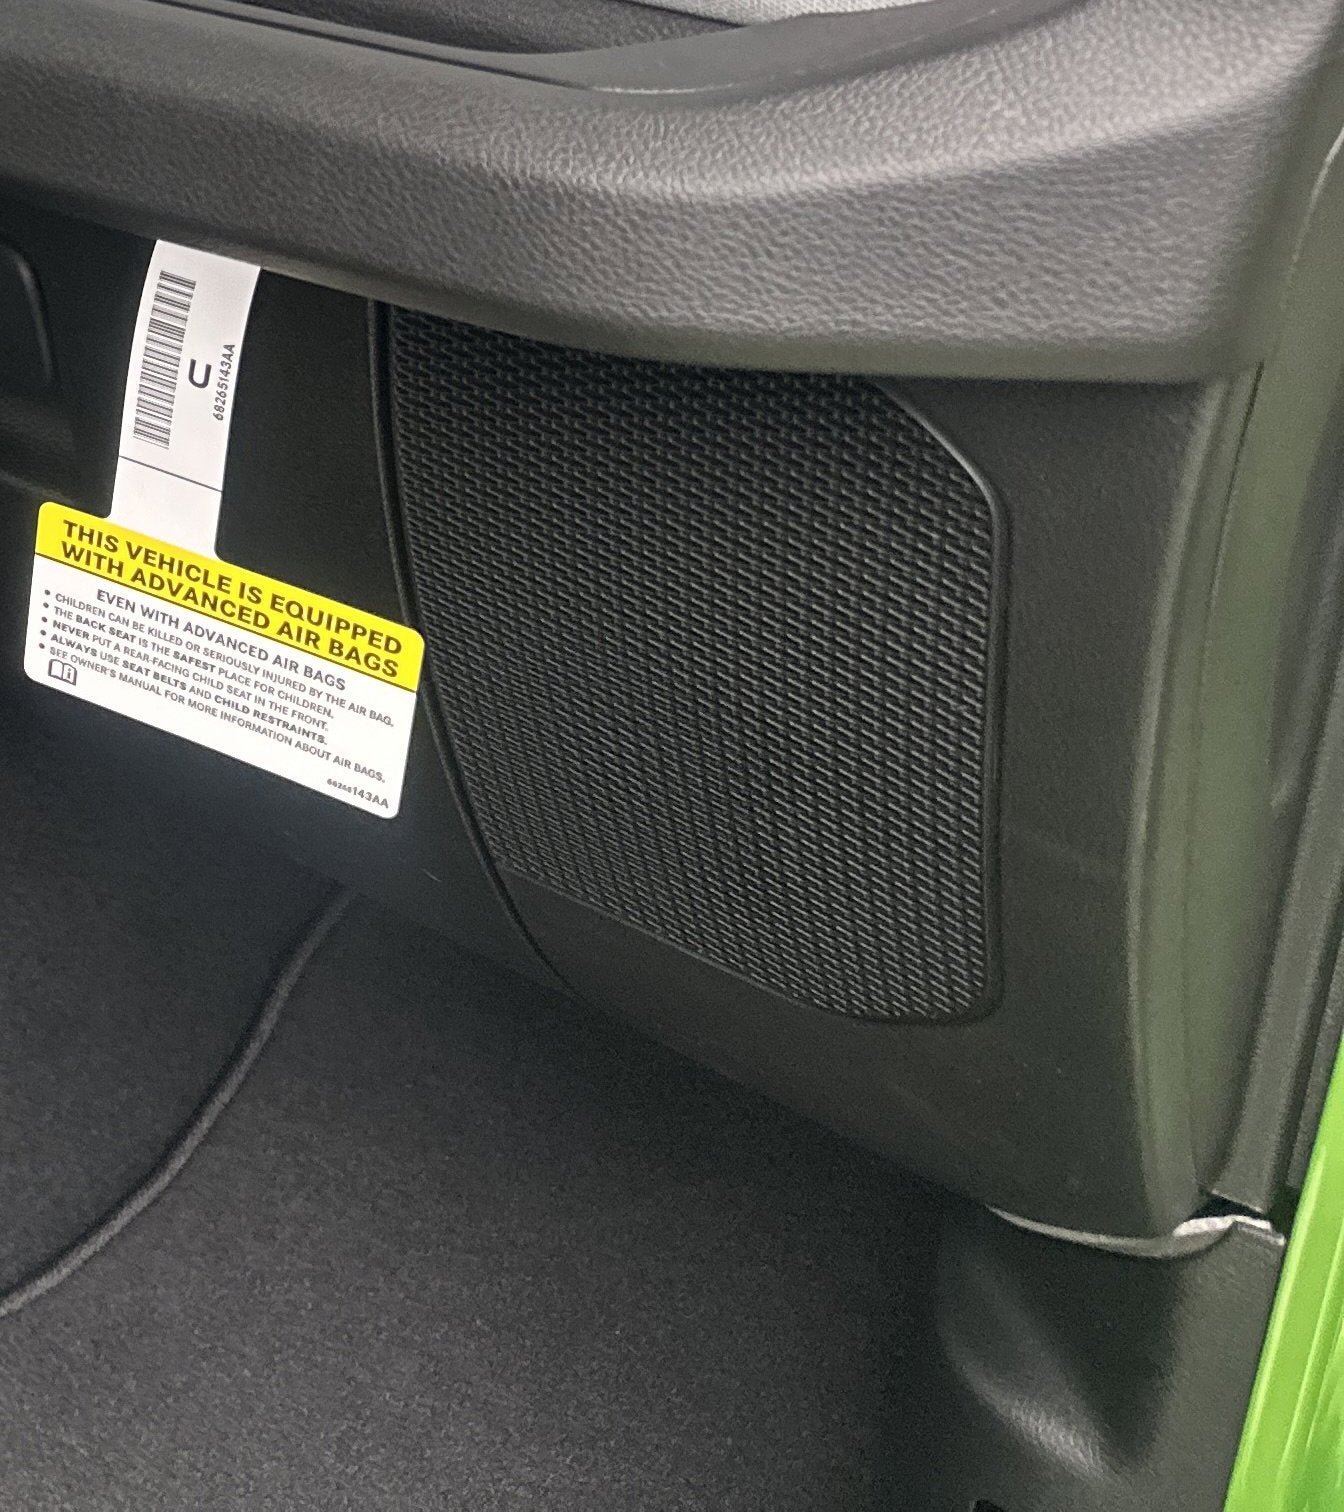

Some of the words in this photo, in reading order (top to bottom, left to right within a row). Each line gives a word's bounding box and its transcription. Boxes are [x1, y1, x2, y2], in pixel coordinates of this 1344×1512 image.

[188, 358, 212, 389] U
[212, 344, 236, 421] 68265143AA
[59, 539, 124, 578] WITH
[130, 565, 271, 632] ADVANCED
[275, 618, 321, 650] AIR
[328, 637, 399, 679] BAGS
[61, 517, 119, 555] THIS
[123, 540, 232, 595] VEHICLE
[238, 581, 263, 607] IS
[269, 592, 403, 657] EQUIPPED
[50, 631, 97, 658] ALWAYS
[99, 650, 120, 667] USE
[121, 658, 150, 678] SEAT
[152, 670, 187, 692] BELTS
[188, 684, 211, 702] AND
[213, 693, 250, 716] CHILD
[52, 618, 90, 642] NEVER
[91, 633, 112, 650] PUT
[113, 641, 121, 654] A
[123, 645, 190, 680] REAR-FACING
[191, 671, 224, 693] CHILD
[225, 684, 252, 703] SEAT
[253, 694, 266, 709] IN
[267, 699, 288, 717] THE
[53, 604, 73, 621] THE
[75, 613, 106, 633] BACK
[108, 625, 136, 645] SEAT
[138, 636, 148, 649] IS
[150, 641, 170, 658] THE
[172, 649, 216, 675] SAFEST
[217, 666, 251, 688] PLACE
[253, 680, 275, 697] FOR
[54, 591, 105, 620] CHILDREN
[107, 611, 129, 629] CAN
[131, 620, 145, 635] BE
[147, 625, 183, 649] KILLED
[184, 639, 200, 655] OR
[202, 646, 260, 678] SERIOUSLY
[261, 668, 306, 695] INJURED
[308, 686, 323, 701] BY
[324, 691, 346, 710] THE
[347, 700, 367, 717] AIR
[96, 587, 136, 613] EVEN
[139, 603, 179, 630] WITH
[182, 619, 269, 663] ADVANCED
[272, 652, 299, 674] AIR
[303, 663, 346, 692] BAGS
